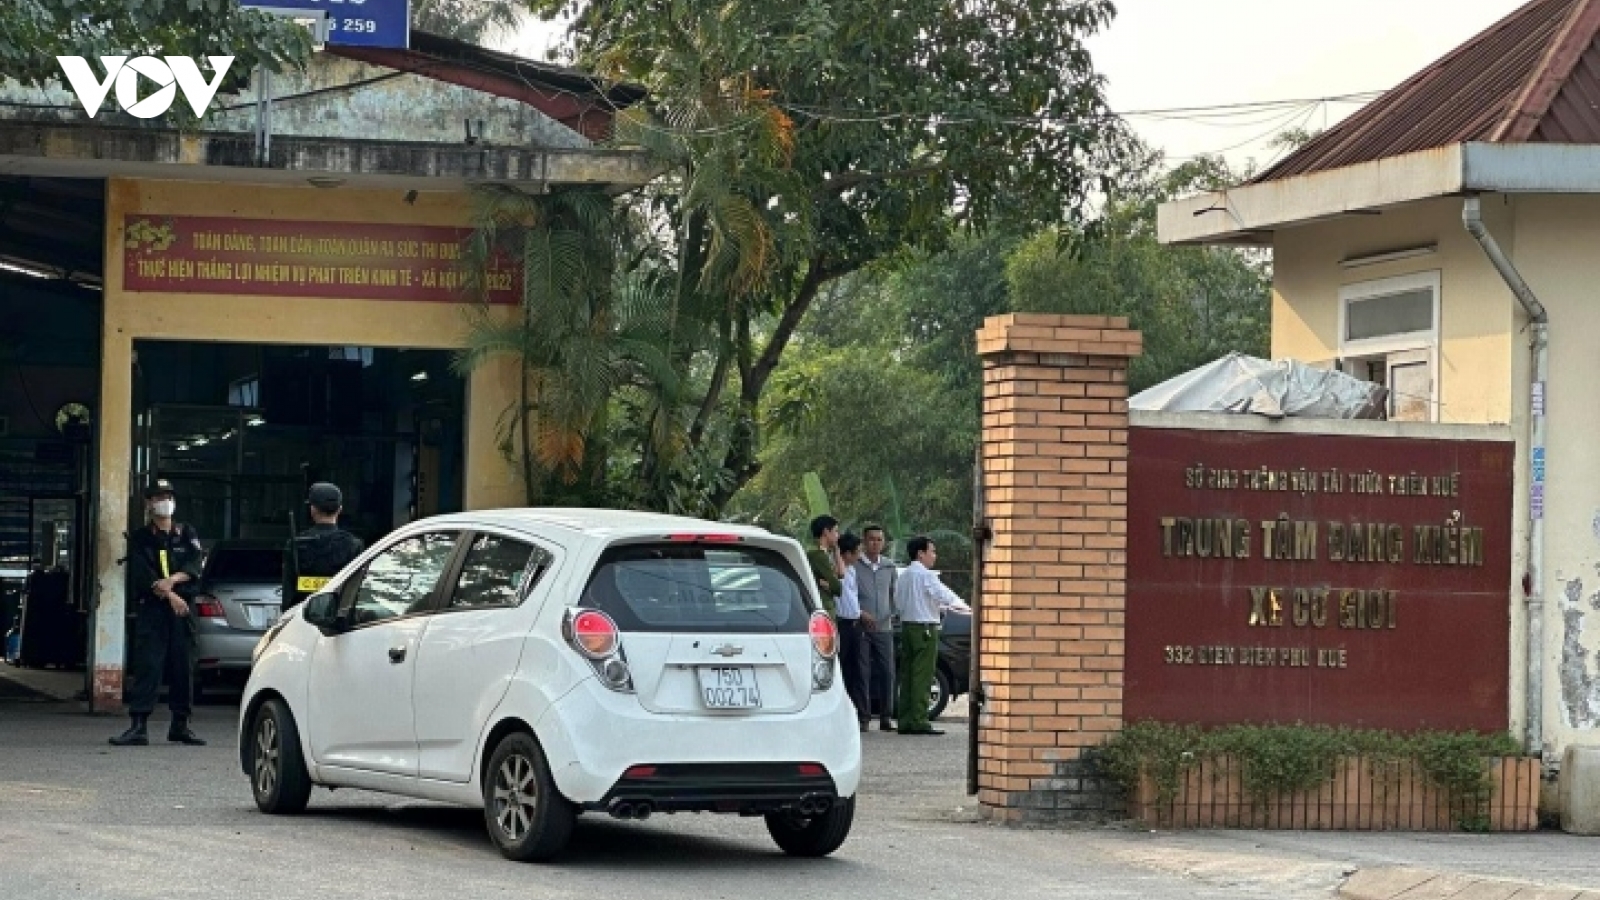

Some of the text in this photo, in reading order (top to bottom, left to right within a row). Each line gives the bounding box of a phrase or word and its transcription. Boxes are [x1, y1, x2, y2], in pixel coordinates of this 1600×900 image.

[342, 18, 377, 33] 259
[1160, 517, 1251, 558] TRUNG
[1261, 512, 1318, 560] TÂM
[1248, 584, 1283, 627] XE
[1164, 645, 1194, 664] 332
